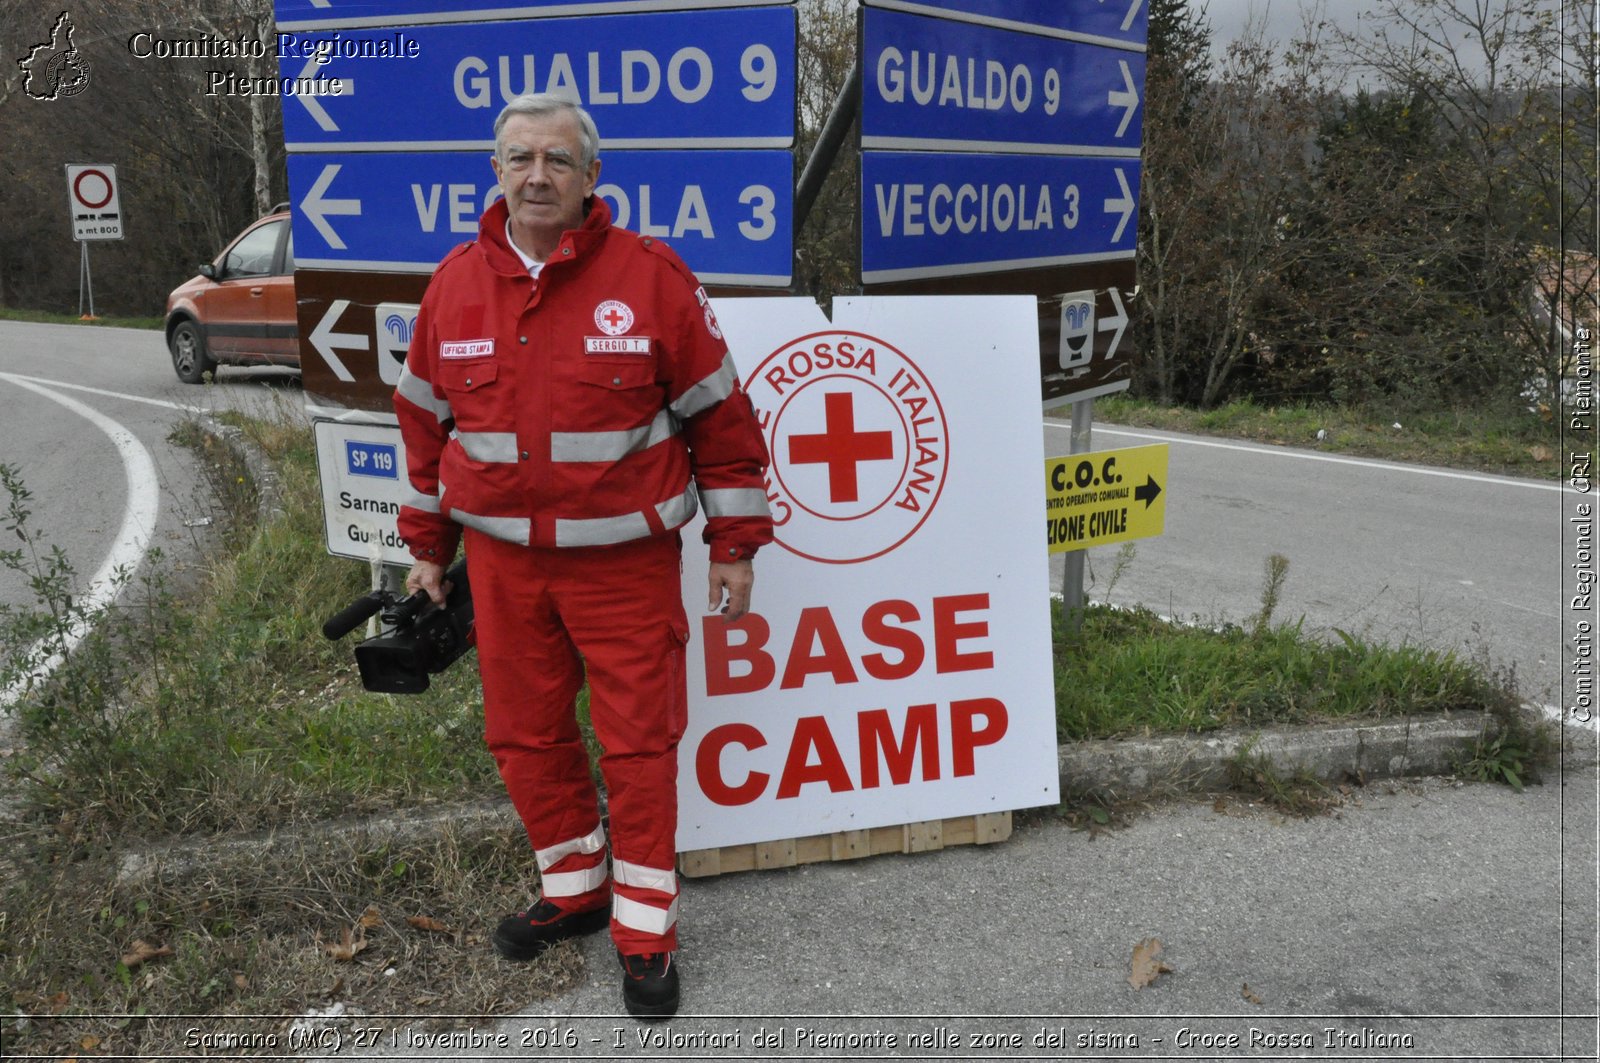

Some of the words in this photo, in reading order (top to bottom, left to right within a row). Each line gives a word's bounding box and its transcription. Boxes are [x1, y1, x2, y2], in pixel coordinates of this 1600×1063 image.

[453, 46, 713, 108] GUALDO
[740, 44, 777, 102] 9
[877, 46, 1033, 113] GUALDO
[1043, 68, 1061, 115] 9
[411, 184, 715, 239] VEOLA
[738, 184, 776, 241] 3
[874, 183, 1054, 237] VECCIOLA
[1063, 184, 1081, 229] 3
[100, 226, 118, 234] 800
[444, 345, 468, 355] UFFICIO
[469, 344, 490, 354] STAMPA
[593, 341, 628, 351] SERGIO
[634, 341, 645, 351] T.
[764, 342, 876, 396] ROSSA
[887, 368, 939, 513] ITALIANA
[352, 450, 368, 468] SP
[373, 452, 392, 470] 119
[1051, 457, 1123, 491] C.O.C.
[340, 491, 400, 515] Sarnan
[1046, 497, 1064, 510] ENTRO
[1066, 491, 1098, 507] OPERATIVO
[1099, 487, 1130, 502] COMUNALE
[348, 524, 405, 548] Guldo
[1047, 514, 1086, 545] ZIONE
[1088, 507, 1128, 538] CIVILE
[702, 593, 994, 697] BASE
[695, 697, 1009, 807] CAMP
